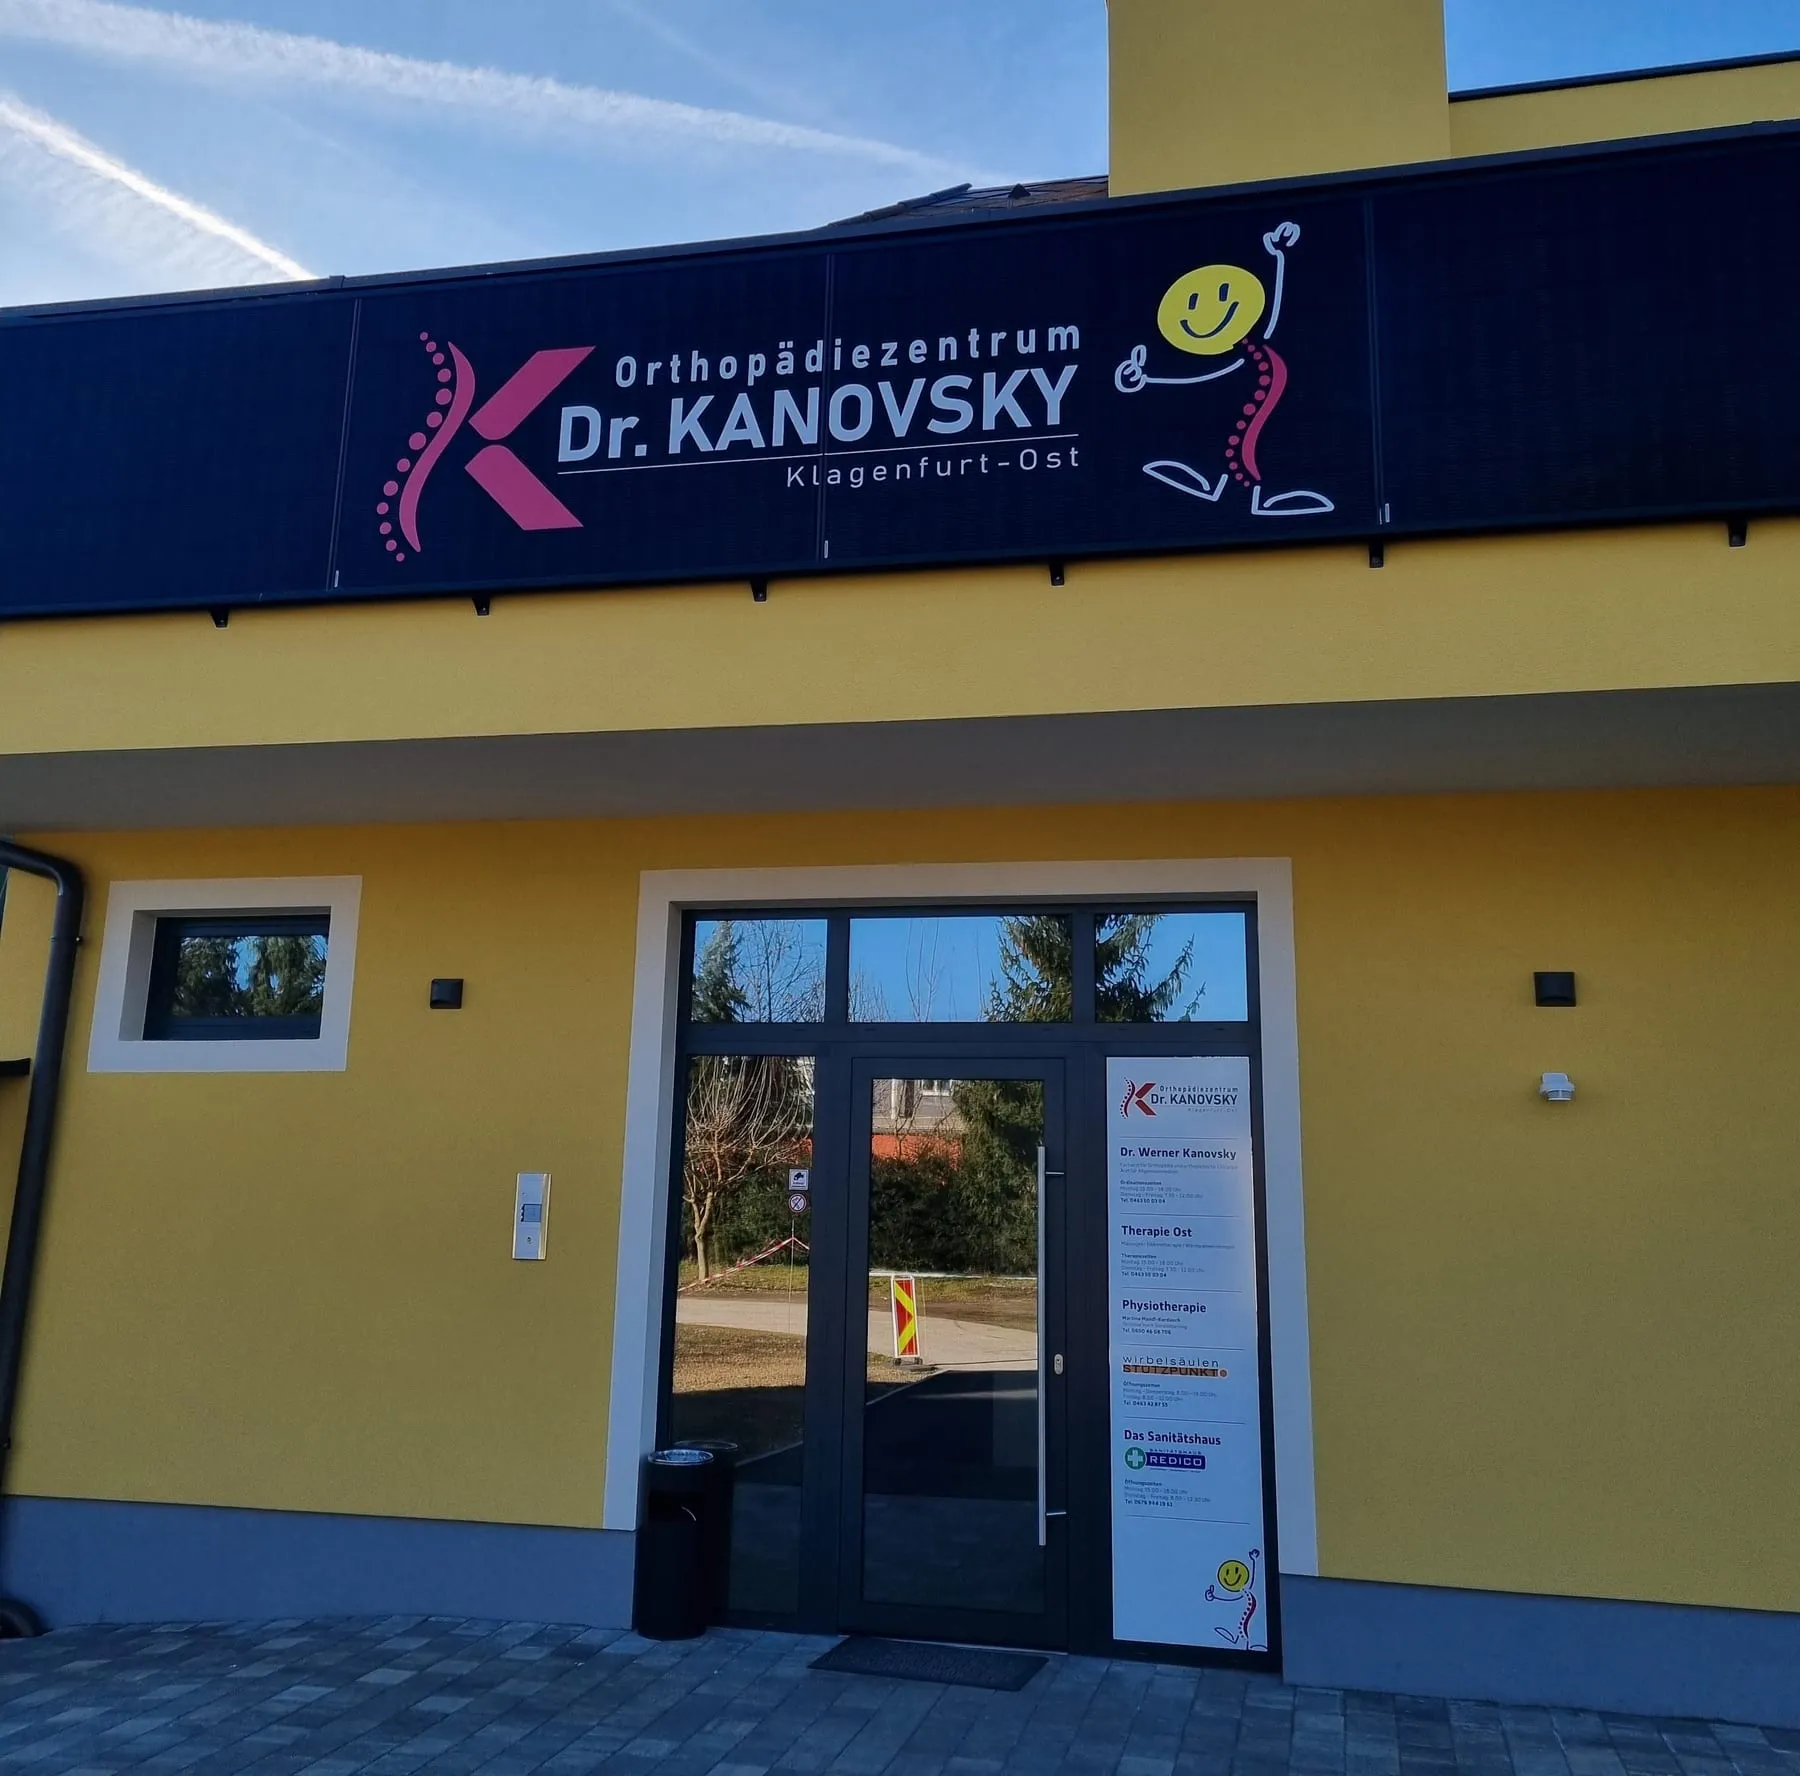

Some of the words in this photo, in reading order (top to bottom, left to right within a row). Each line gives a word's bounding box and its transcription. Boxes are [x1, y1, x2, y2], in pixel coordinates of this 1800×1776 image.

[615, 324, 1080, 387] Orthopädiezentrum
[558, 405, 648, 462] Dr.
[668, 364, 1079, 454] KANOVSKY
[787, 447, 1079, 488] Klagenfurt-Ost
[1159, 1085, 1239, 1094] Orthopädiezentrum
[1151, 1094, 1167, 1105] Dr.
[1170, 1094, 1238, 1105] KANOVSKY
[1120, 1147, 1136, 1157] Dr.
[1139, 1147, 1180, 1158] Werner
[1183, 1148, 1237, 1161] Kanovsky
[1121, 1225, 1170, 1238] Therapie
[1173, 1227, 1193, 1237] Ost
[1122, 1300, 1206, 1314] Physiotherapie
[1122, 1355, 1219, 1368] wirbelsäulen
[1124, 1430, 1145, 1440] Das
[1147, 1431, 1222, 1445] Sanitätshaus
[1150, 1455, 1203, 1467] REDICO
